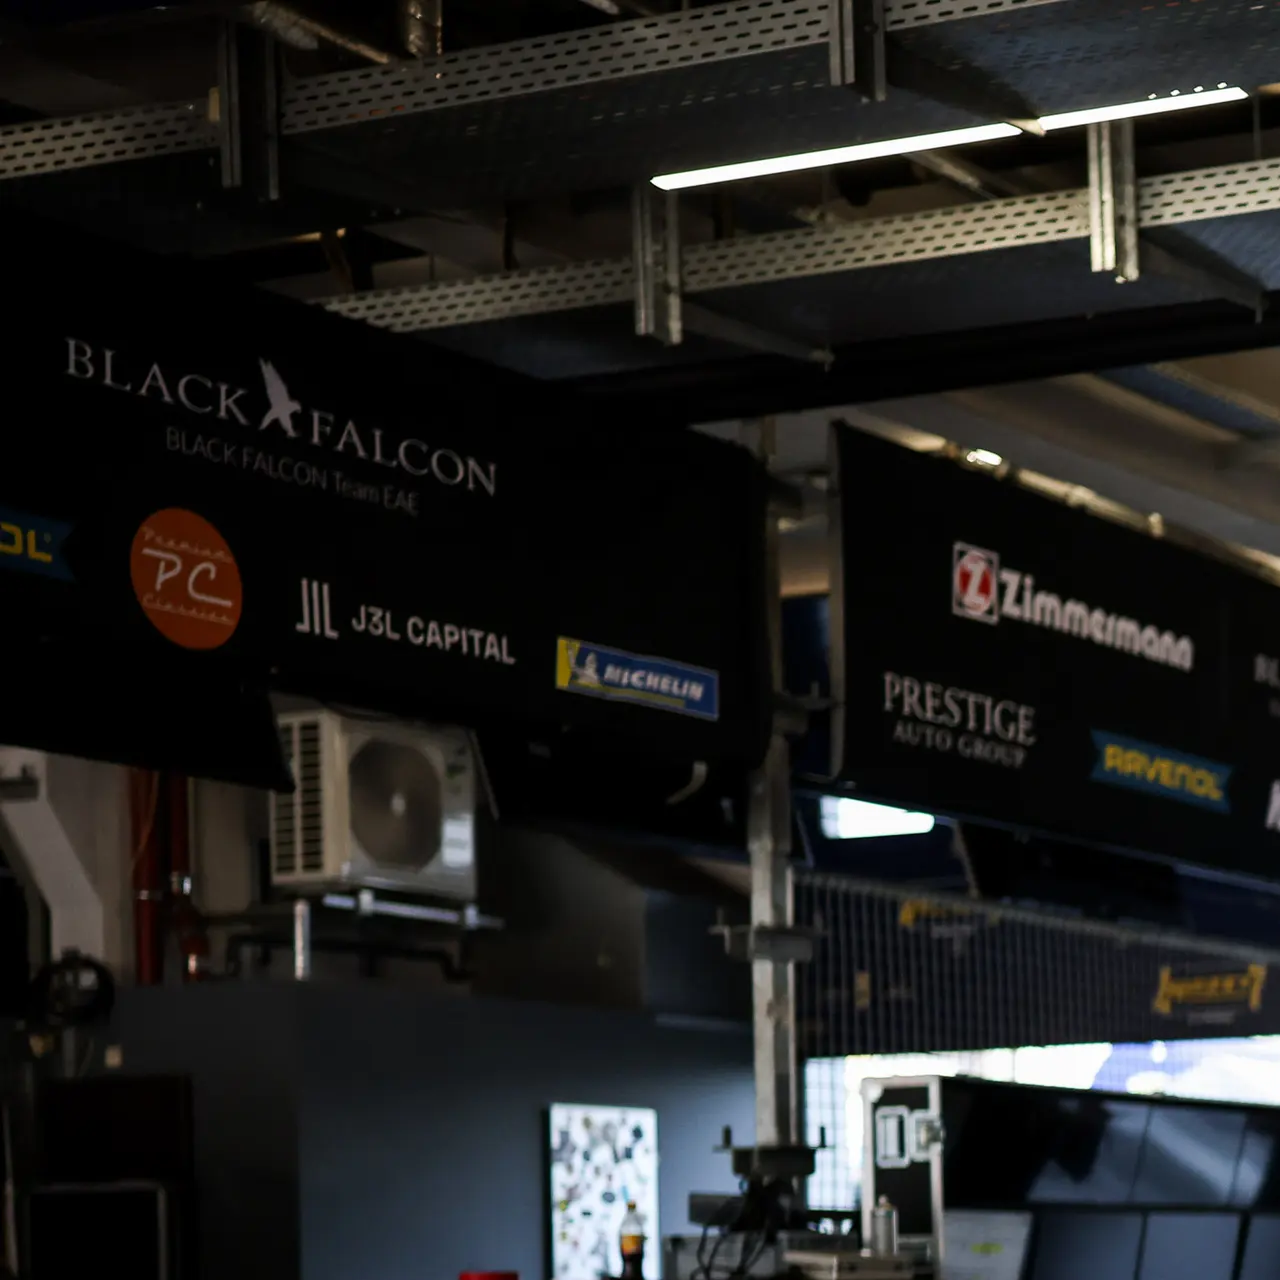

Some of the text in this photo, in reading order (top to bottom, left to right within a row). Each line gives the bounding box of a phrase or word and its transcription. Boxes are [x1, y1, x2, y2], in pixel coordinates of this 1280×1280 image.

[64, 335, 498, 496] BLACK FALCON
[165, 425, 237, 468] BLACK
[242, 444, 328, 492] FALCON
[141, 547, 233, 607] PC
[352, 603, 517, 666] J3L CAPITAL
[1000, 565, 1196, 674] Zimmermann
[603, 662, 706, 701] MICHELIN
[882, 670, 1038, 747] PRESTIGE
[893, 719, 952, 752] AUTO
[1104, 742, 1224, 801] RAVENOL
